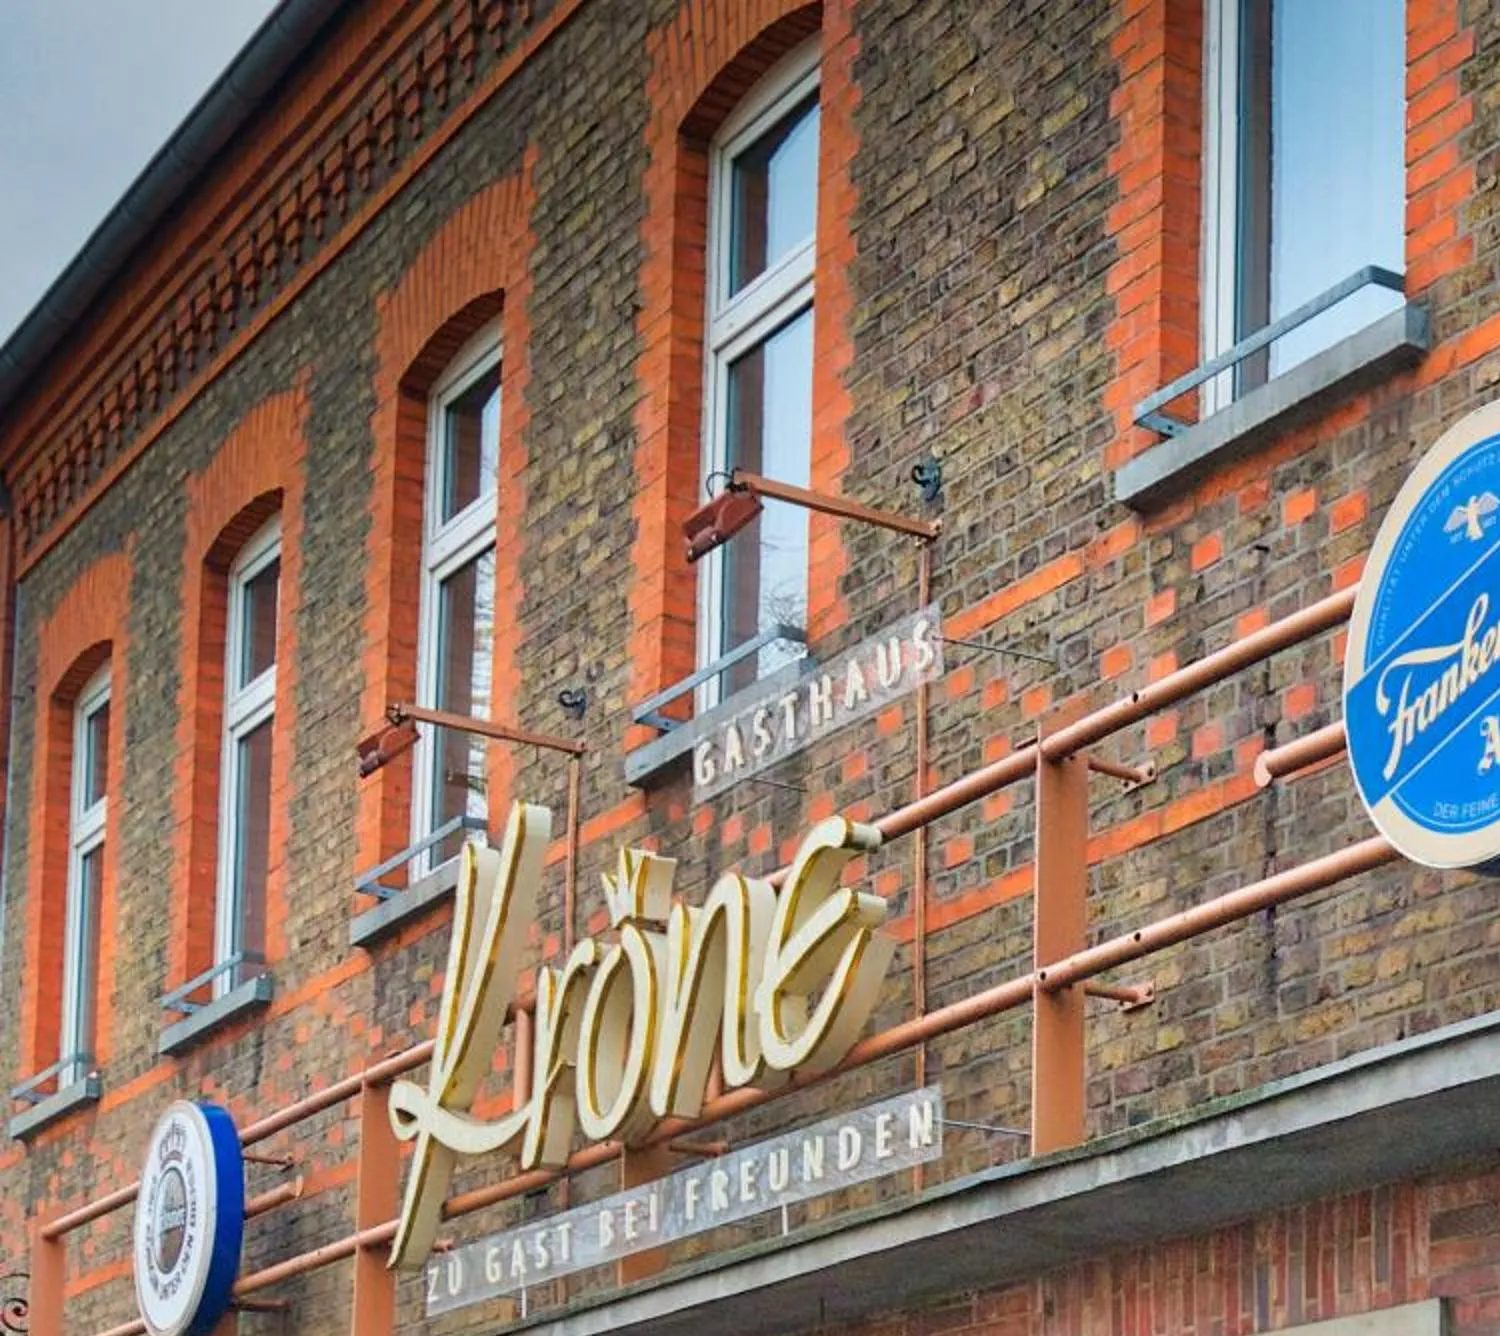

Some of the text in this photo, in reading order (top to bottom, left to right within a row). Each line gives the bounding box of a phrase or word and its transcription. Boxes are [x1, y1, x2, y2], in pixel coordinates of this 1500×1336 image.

[694, 619, 934, 786] GASTHAUS
[1433, 801, 1459, 819] DER
[1461, 792, 1499, 817] FEINE
[427, 1100, 933, 1301] ZU GAST BEI FREUNDEN
